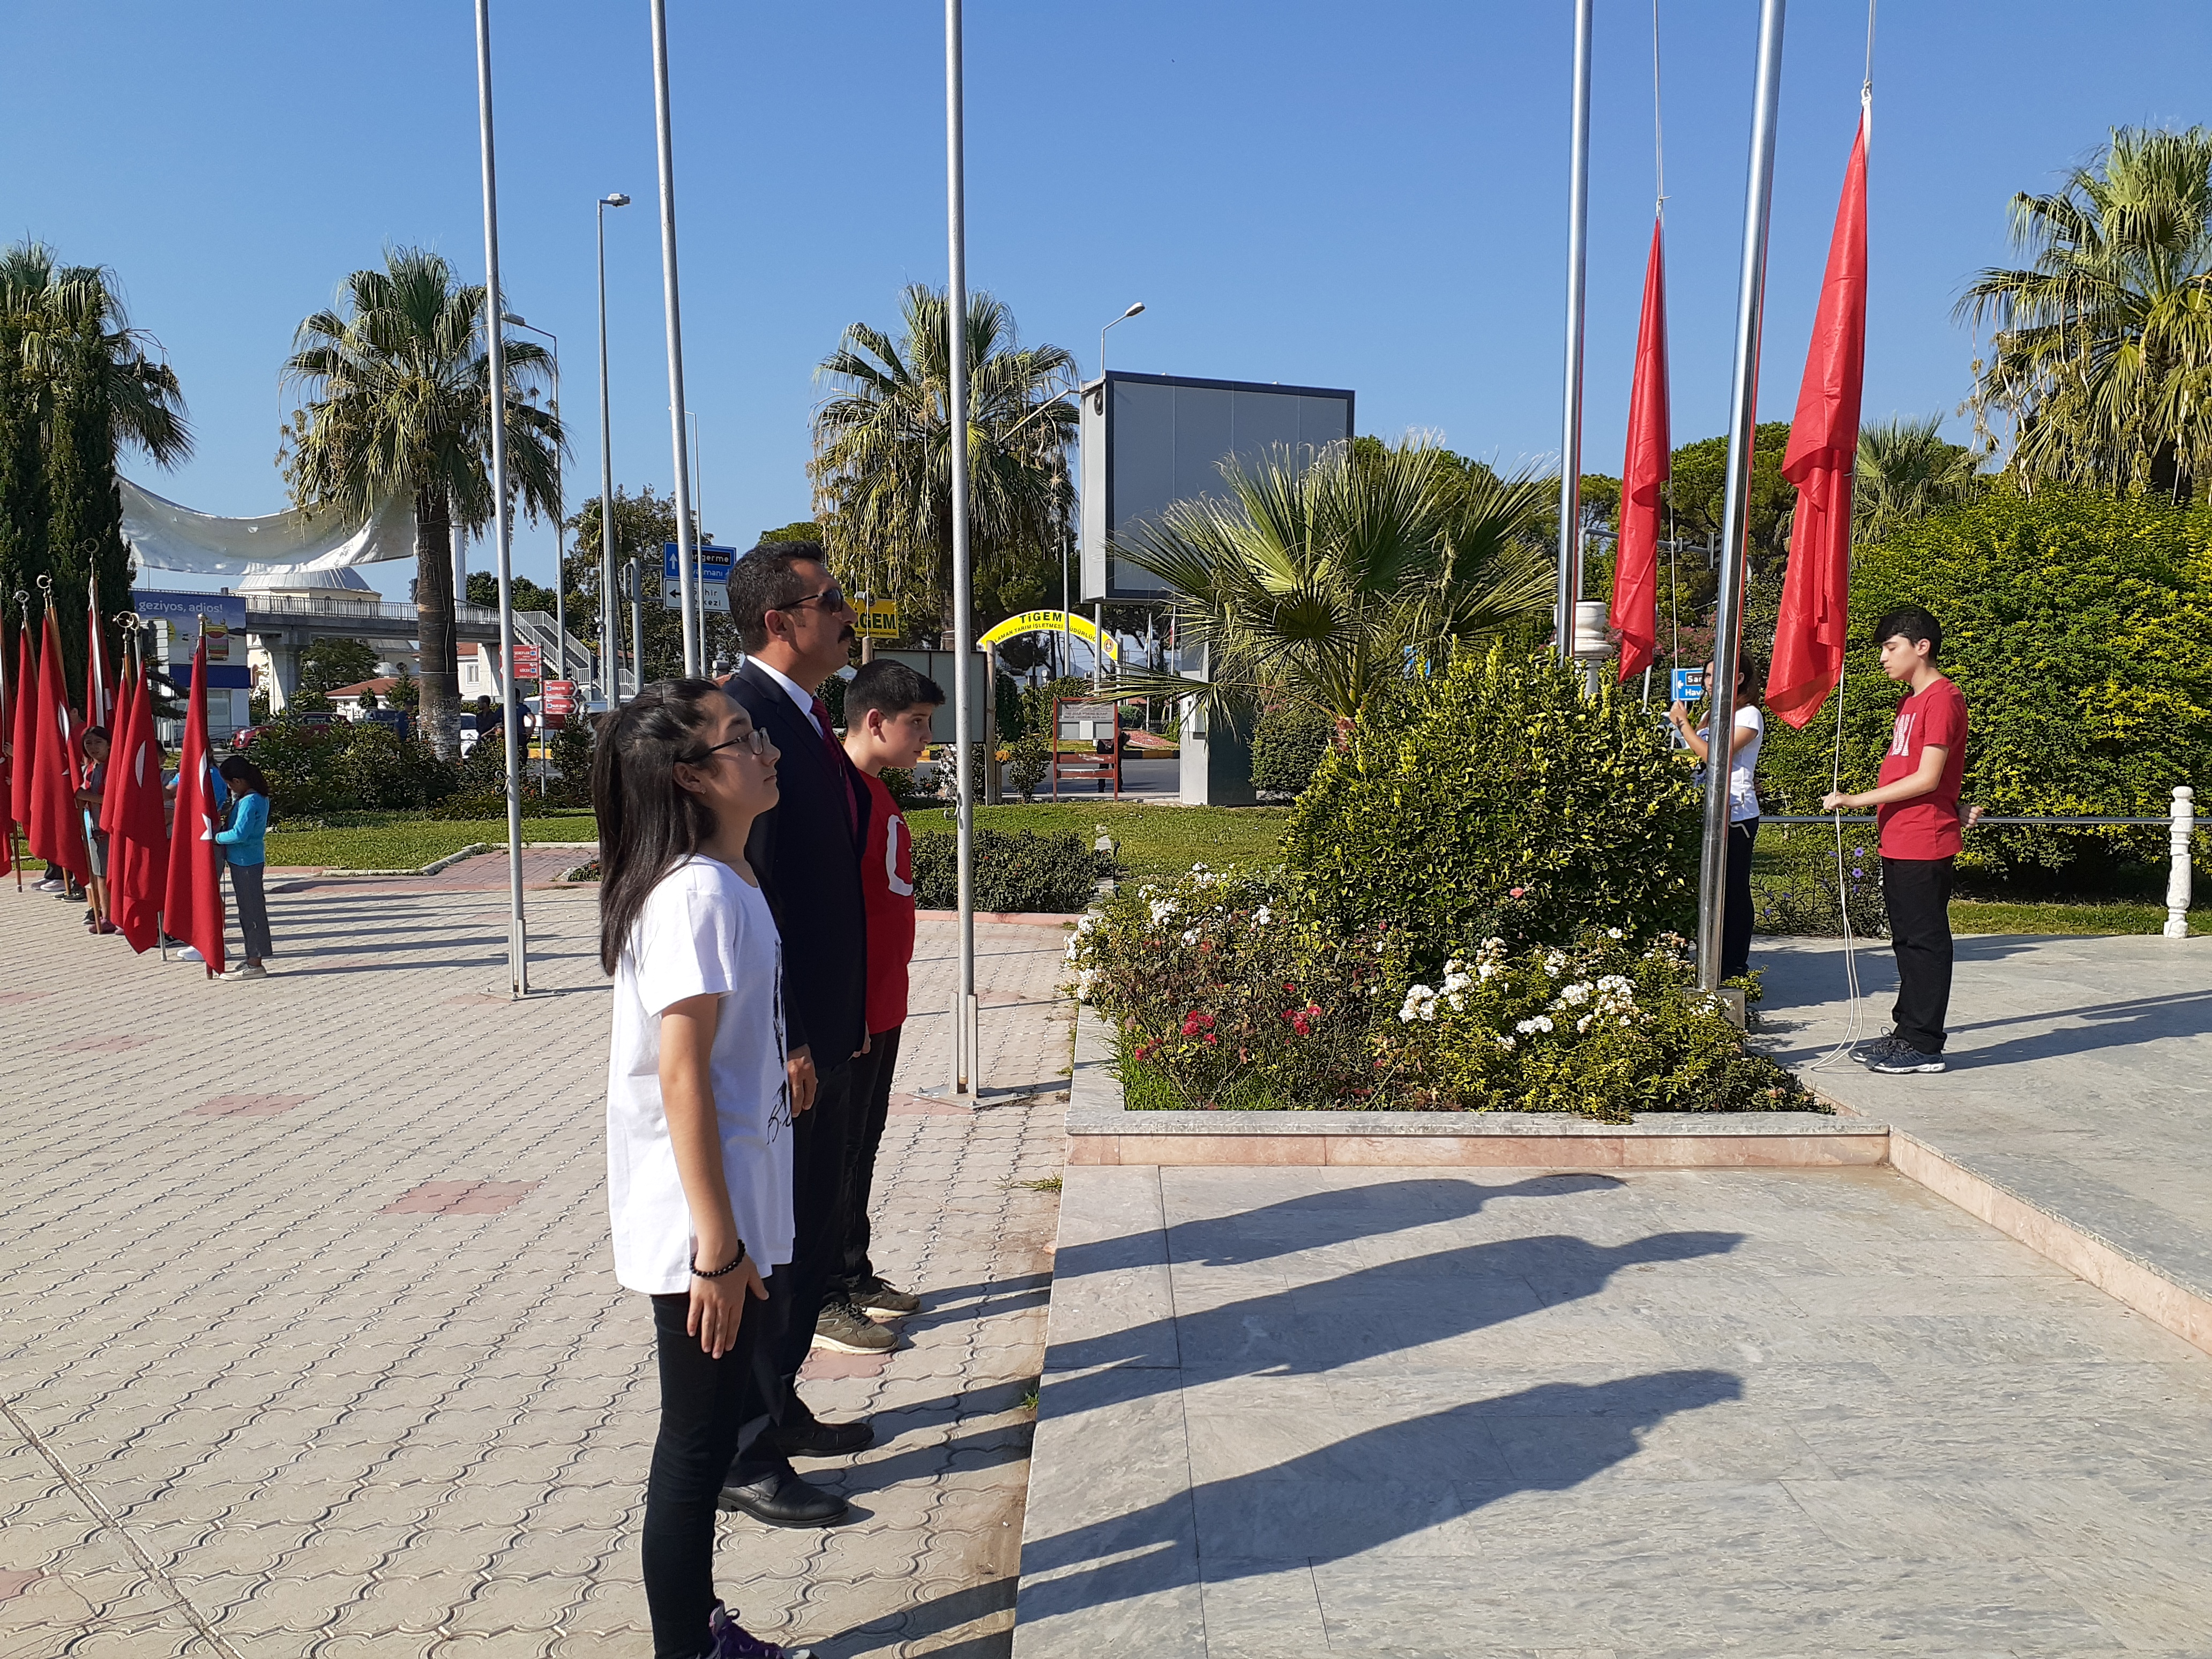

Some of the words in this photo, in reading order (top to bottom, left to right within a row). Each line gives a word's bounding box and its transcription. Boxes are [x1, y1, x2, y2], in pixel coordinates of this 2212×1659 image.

[692, 554, 729, 563] rgerme
[138, 600, 186, 613] geziyos,
[189, 602, 223, 613] adios!
[854, 607, 896, 630] İGEM
[994, 629, 1014, 643] LAMAN
[1013, 624, 1032, 633] TARIM
[1032, 622, 1064, 630] İŞLETMESİ
[1069, 626, 1097, 642] ÜDÜRLÜ
[1685, 688, 1701, 696] Hav
